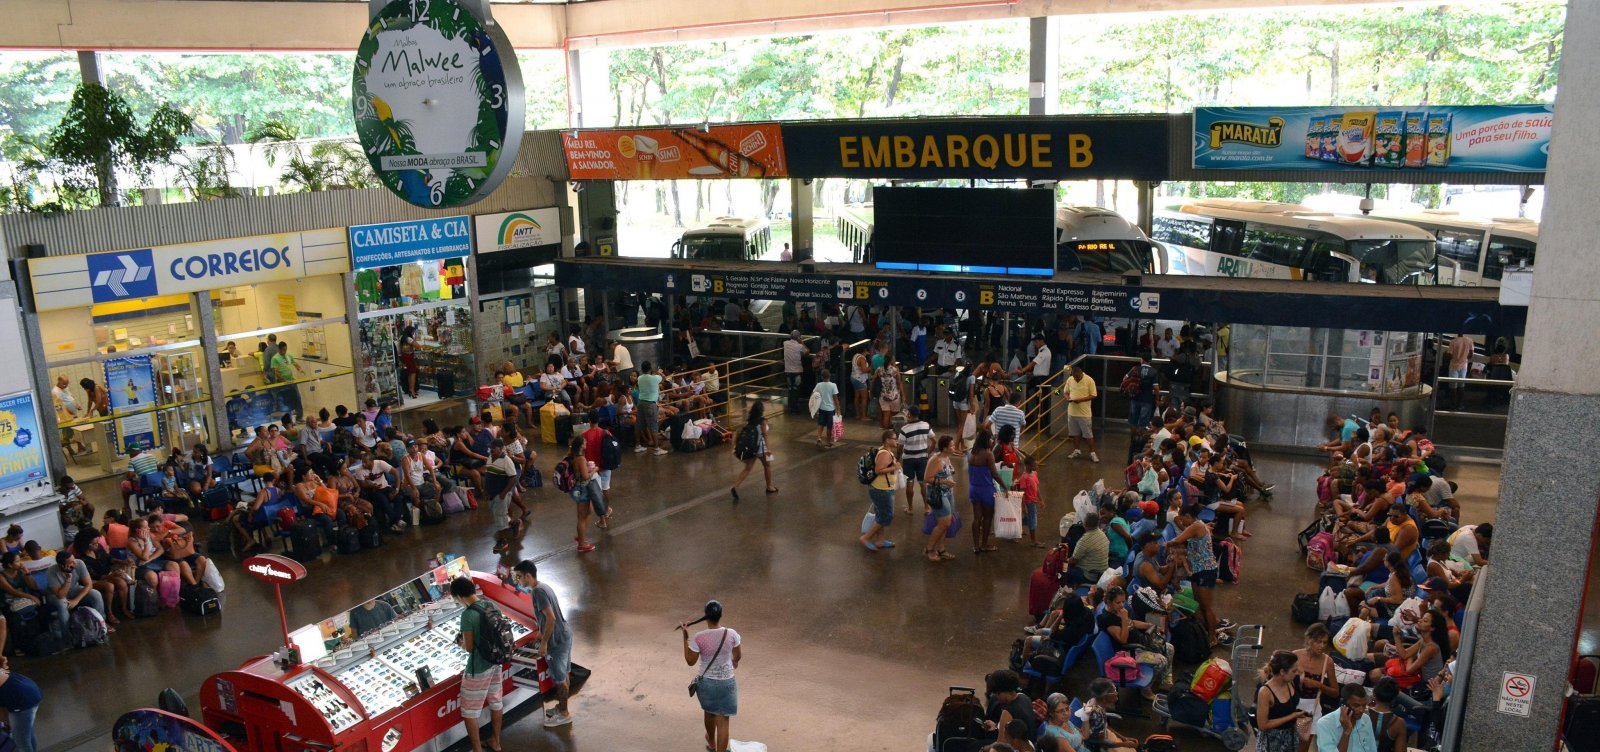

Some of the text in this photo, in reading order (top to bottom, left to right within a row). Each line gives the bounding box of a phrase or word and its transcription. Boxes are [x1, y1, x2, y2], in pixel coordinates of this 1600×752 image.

[409, 0, 430, 22] 12
[382, 49, 464, 77] Malwee
[384, 81, 396, 89] um
[428, 74, 464, 88] brasileiro
[490, 84, 503, 109] 3
[356, 96, 368, 119] 9
[1222, 124, 1281, 145] MARATÁ
[1455, 129, 1477, 141] Uma
[1478, 121, 1510, 136] porção
[1511, 119, 1524, 129] de
[568, 140, 583, 149] MEU
[1468, 134, 1492, 148] para
[1493, 132, 1512, 141] seu
[570, 150, 611, 159] BEM-VINDO
[839, 133, 1094, 170] EMBARQUE B
[389, 158, 407, 168] Nossa
[407, 156, 428, 167] MODA
[429, 155, 450, 167] abraça
[430, 181, 443, 206] 6
[353, 220, 469, 248] CAMISETA & CIA
[513, 226, 534, 237] ANTT
[394, 248, 431, 259] ARTESANATOS
[435, 243, 469, 254] LEMBRANÇAS
[170, 245, 291, 281] CORREIOS
[713, 279, 724, 293] B
[856, 286, 869, 299] B
[998, 284, 1022, 292] Nacional
[1056, 288, 1084, 296] Expresso
[980, 290, 994, 305] B
[1042, 294, 1064, 302] Rápido
[0, 396, 31, 409] ASCER FELIZ
